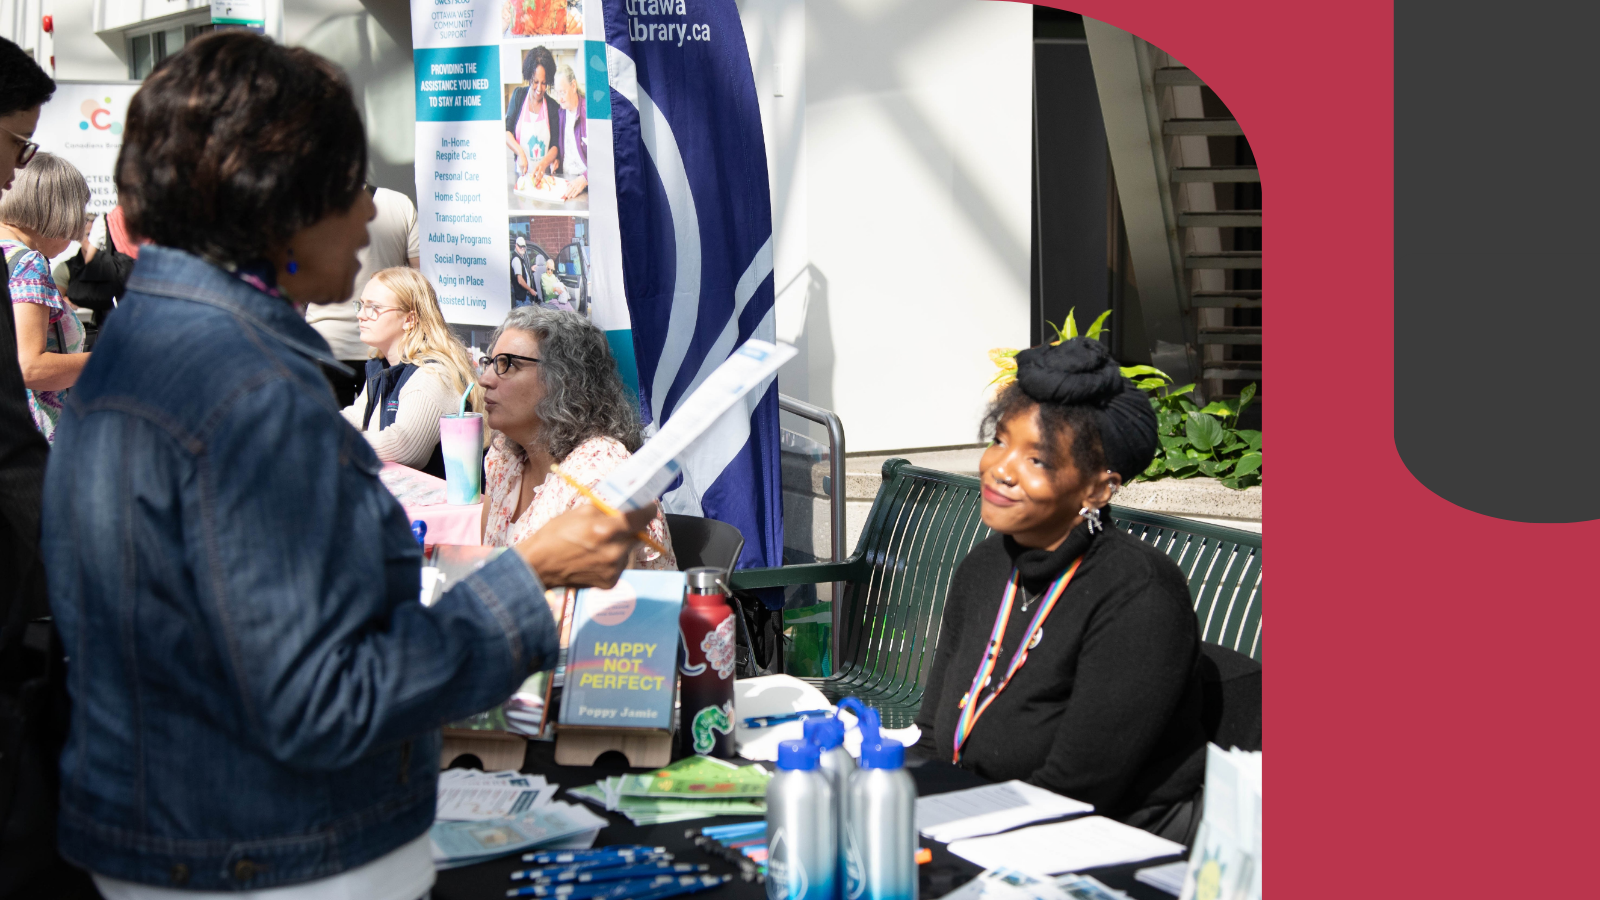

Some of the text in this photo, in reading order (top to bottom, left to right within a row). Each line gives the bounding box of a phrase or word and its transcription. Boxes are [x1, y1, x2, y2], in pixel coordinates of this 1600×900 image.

[626, 0, 687, 15] ttawa
[431, 10, 474, 20] OTTAWA WEST
[434, 20, 473, 29] COMMUNITY
[440, 30, 467, 39] SUPPORT
[430, 62, 477, 75] PROVIDING THE
[420, 78, 489, 91] ASSISTANCE YOU NEED
[429, 96, 481, 107] TO STAY AT HOME
[441, 137, 470, 147] In-Home
[435, 151, 476, 161] Respite Care
[85, 175, 110, 183] CTER
[434, 171, 479, 181] Personal Care
[434, 192, 481, 204] Home Support
[435, 212, 482, 224] Transportation
[428, 233, 491, 246] Adult Day Programs
[434, 254, 486, 267] Social Programs
[438, 275, 484, 287] Aging in Place
[438, 296, 486, 309] Assisted Living
[594, 641, 657, 658] HAPPY
[603, 658, 643, 673] NOT
[579, 673, 665, 691] PERFECT
[578, 705, 658, 719] Poppy Jamie
